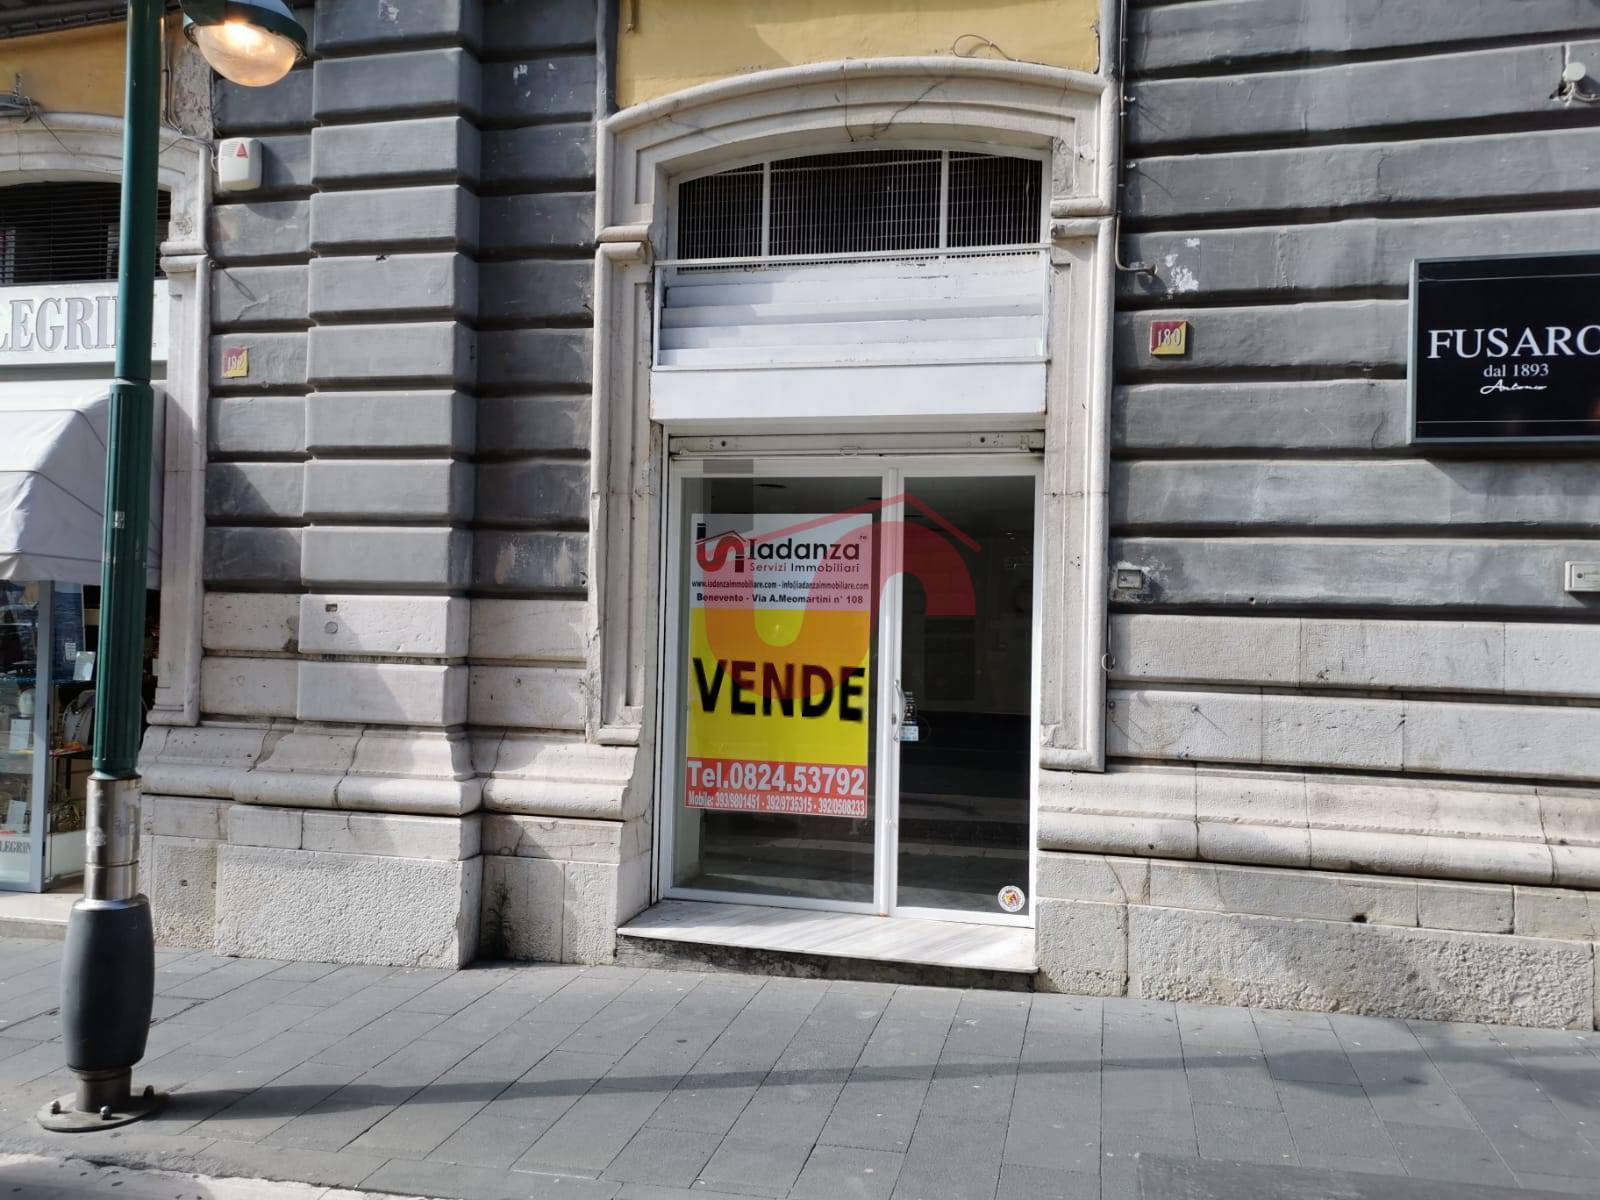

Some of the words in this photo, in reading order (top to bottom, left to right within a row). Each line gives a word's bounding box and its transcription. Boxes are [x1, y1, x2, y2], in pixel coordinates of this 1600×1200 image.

[1157, 328, 1182, 347] 180
[1483, 364, 1506, 377] dal
[1513, 363, 1549, 377] 1893
[748, 538, 860, 560] Iadanza
[750, 562, 787, 572] Servizi
[791, 562, 860, 573] Immobiliari
[696, 592, 744, 602] Benevento
[752, 594, 767, 602] Via
[769, 594, 831, 604] A.Meomartini
[846, 595, 864, 605] 108
[692, 657, 866, 722] VENDE
[687, 760, 865, 796] Tel.0824.53792
[688, 790, 714, 807] Mobile:
